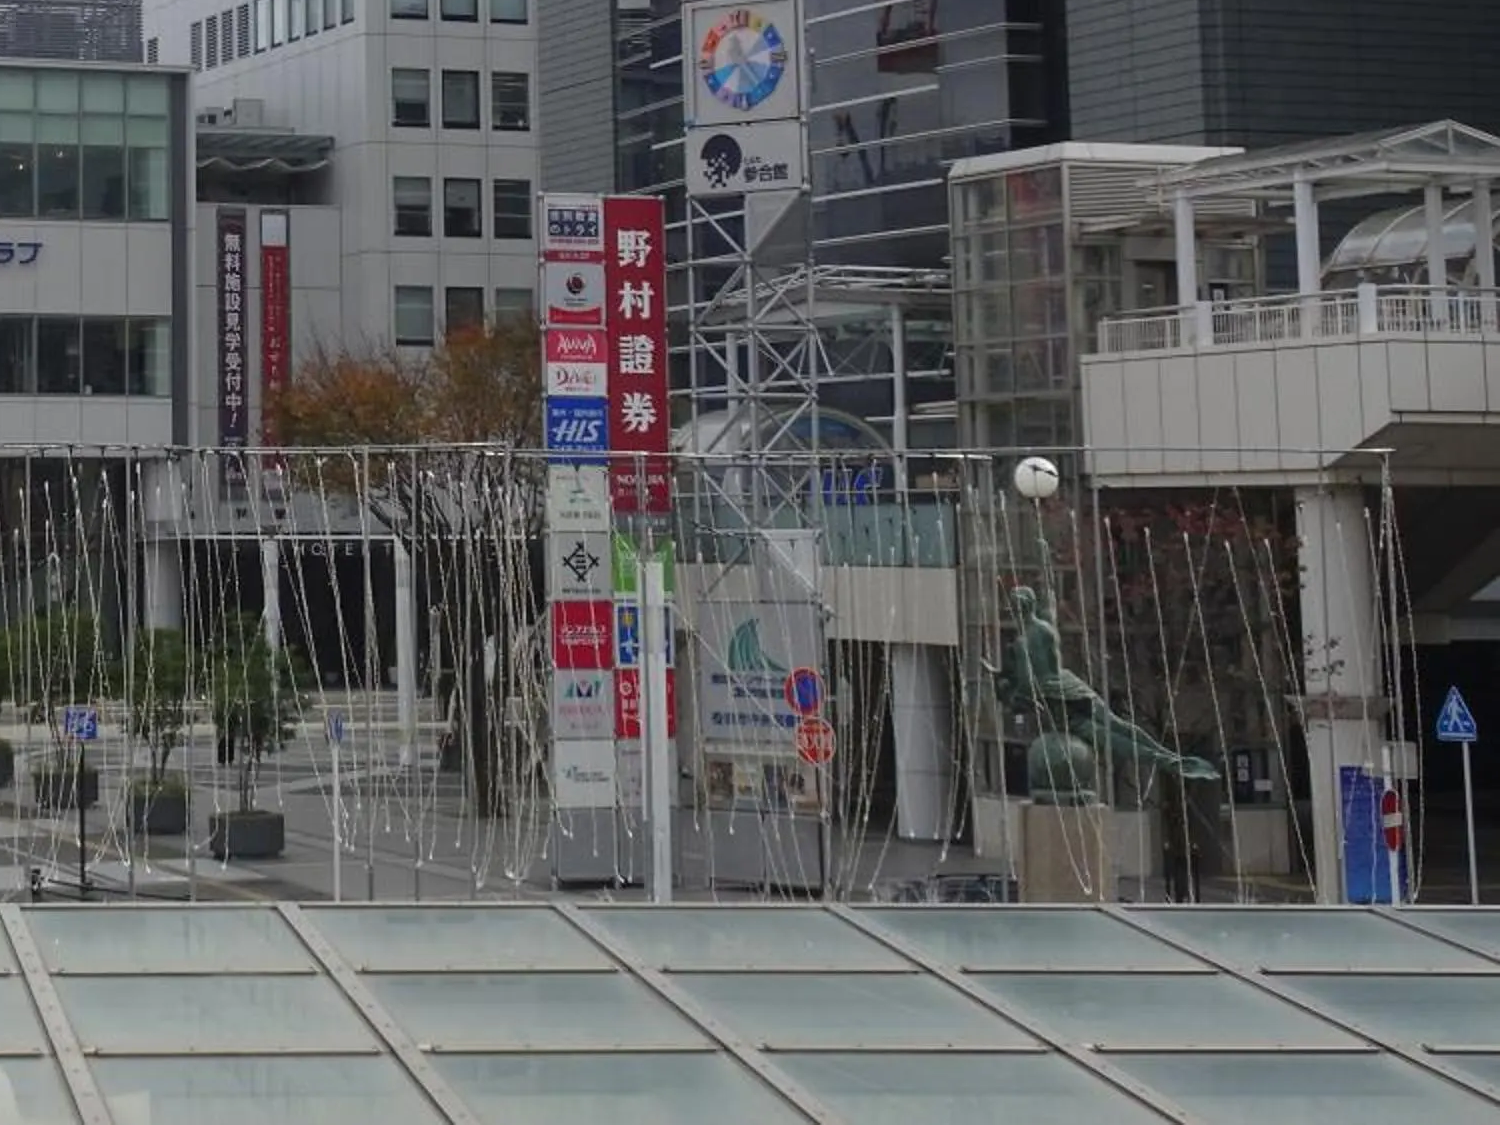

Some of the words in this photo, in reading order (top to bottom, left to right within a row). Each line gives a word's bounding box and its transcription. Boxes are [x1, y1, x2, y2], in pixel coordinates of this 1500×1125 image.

[617, 229, 657, 433] 野村證券
[552, 419, 603, 443] HIS
